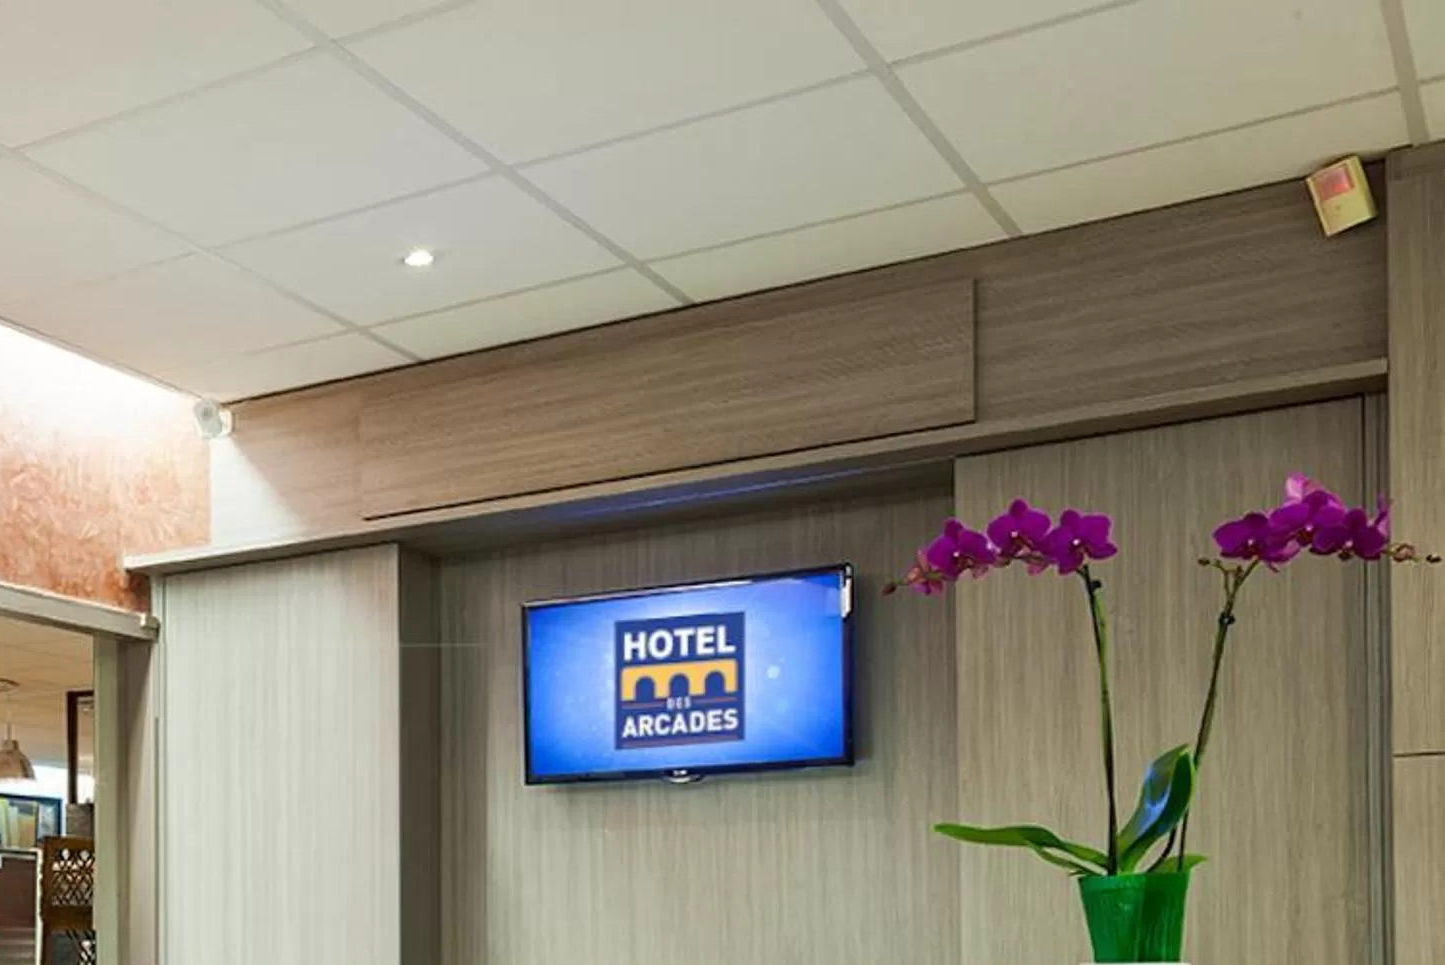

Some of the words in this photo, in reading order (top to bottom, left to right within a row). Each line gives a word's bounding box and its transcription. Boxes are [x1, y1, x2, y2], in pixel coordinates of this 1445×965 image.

[623, 625, 736, 661] HOTEL
[666, 696, 691, 709] DES
[622, 709, 738, 738] ARCADES
